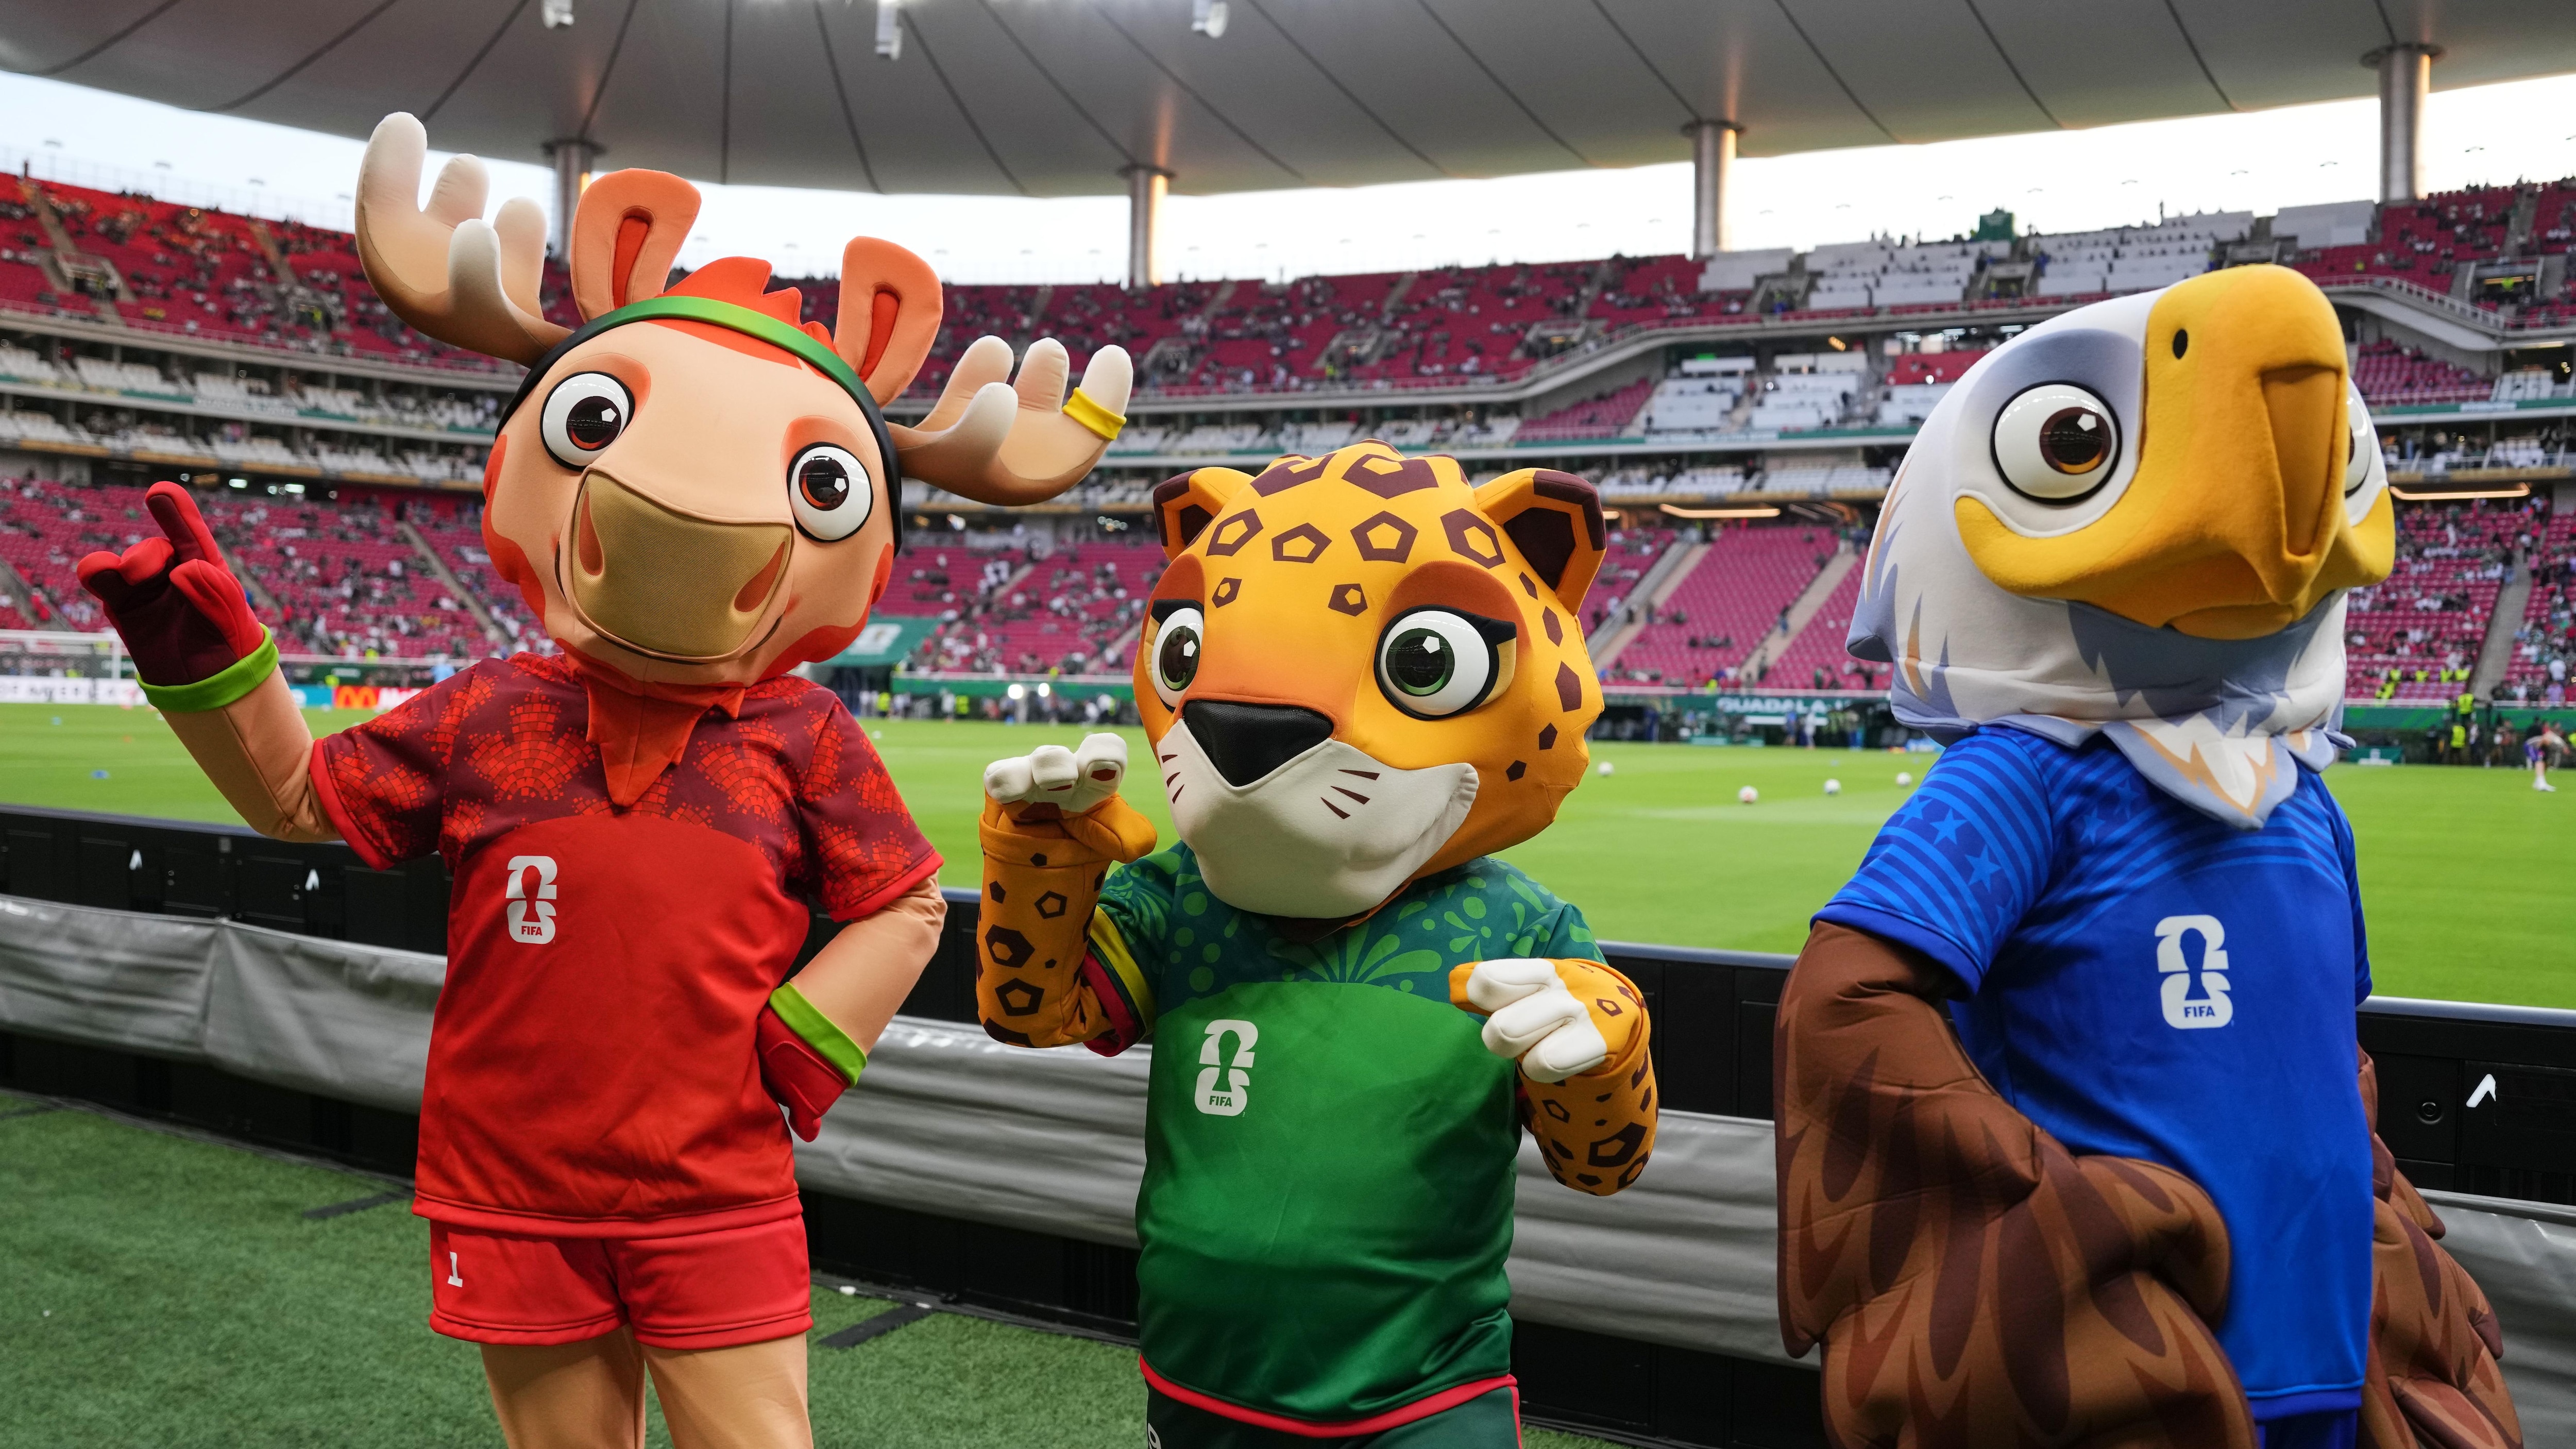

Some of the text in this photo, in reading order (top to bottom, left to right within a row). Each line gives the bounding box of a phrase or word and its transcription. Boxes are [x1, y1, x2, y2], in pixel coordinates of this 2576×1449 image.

[521, 925, 543, 936] FIFA
[2184, 1006, 2216, 1018] FIFA
[1209, 1096, 1232, 1107] FIFA
[447, 1251, 463, 1288] 1
